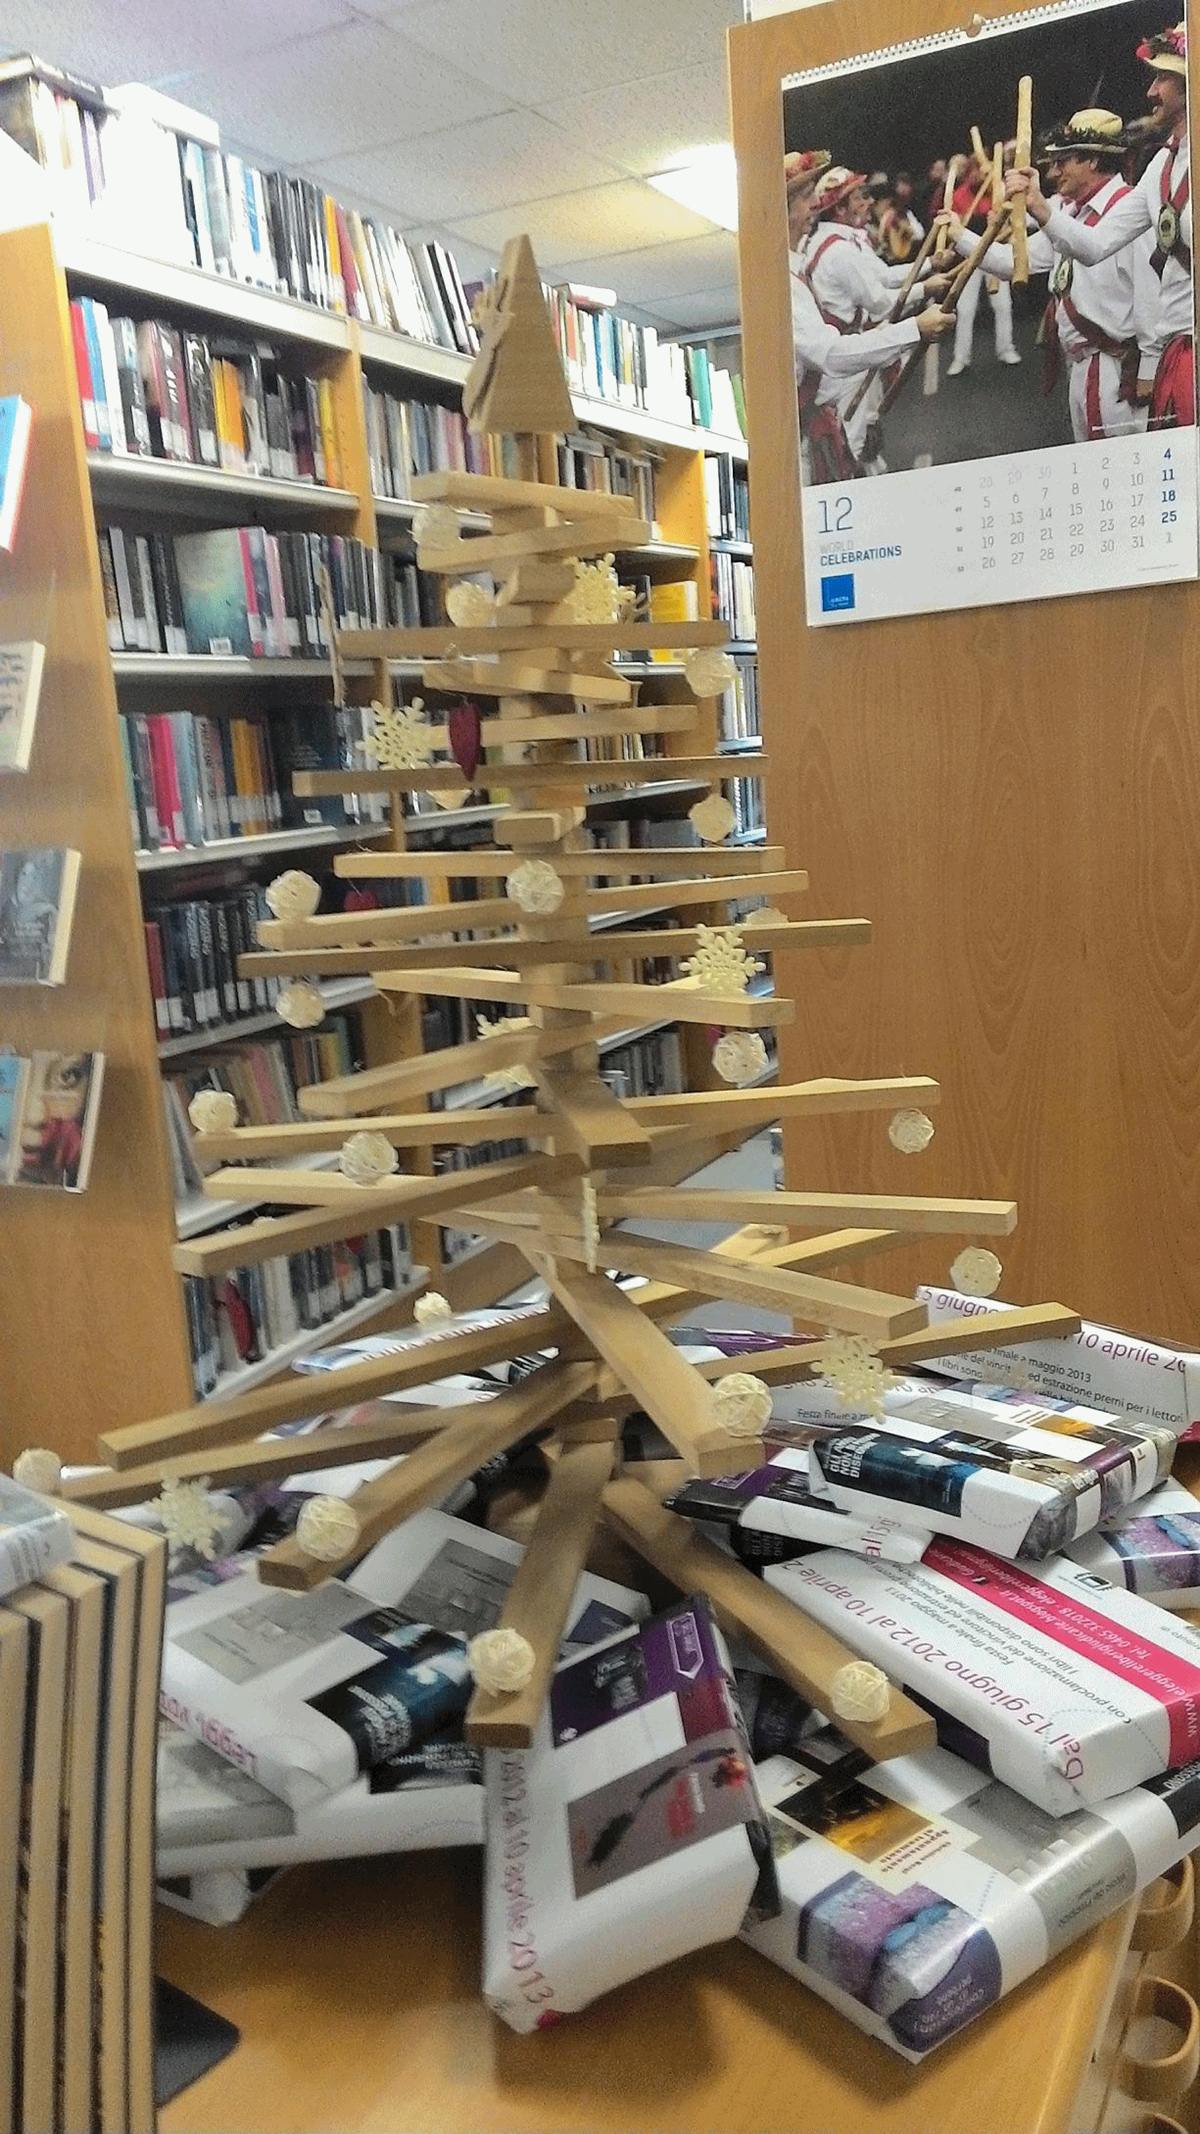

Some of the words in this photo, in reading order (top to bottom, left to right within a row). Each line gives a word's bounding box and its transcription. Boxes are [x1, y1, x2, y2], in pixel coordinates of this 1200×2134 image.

[1072, 463, 1078, 474] 1
[1102, 457, 1110, 469] 2
[1132, 453, 1141, 464] 3
[1163, 448, 1171, 459] 4
[983, 496, 991, 508] 5
[1012, 494, 1020, 504] 6
[1042, 487, 1048, 500] 7
[1072, 483, 1079, 495] 8
[1102, 477, 1110, 490] 9
[1130, 474, 1144, 486] 10
[1162, 469, 1175, 481] 11
[818, 497, 854, 534] 12
[981, 516, 995, 528] 12
[1010, 512, 1023, 525] 13
[1040, 507, 1053, 520] 14
[1070, 503, 1083, 516] 15
[1100, 499, 1113, 511] 16
[1131, 494, 1144, 507] 17
[1161, 490, 1176, 502] 18
[982, 536, 995, 549] 19
[1010, 532, 1025, 545] 20
[1040, 528, 1053, 541] 21
[1069, 523, 1085, 536] 22
[1100, 519, 1115, 532] 23
[1130, 515, 1145, 528] 24
[1161, 510, 1178, 524] 25
[820, 540, 854, 553] WORLD
[820, 545, 902, 567] CELEBRATIONS
[982, 556, 996, 569] 26
[1011, 552, 1025, 565] 27
[1040, 548, 1055, 561] 28
[1070, 544, 1085, 557] 29
[1100, 540, 1115, 553] 30
[1131, 536, 1145, 549] 31
[1165, 532, 1173, 543] 1
[1077, 1331, 1099, 1349] 10
[1101, 1340, 1160, 1367] aprile
[1028, 1357, 1065, 1376] maggio
[1067, 1367, 1091, 1383] 2013
[1028, 1371, 1040, 1382] ed
[1042, 1376, 1093, 1399] estrazione
[1094, 1392, 1125, 1409] premi
[1126, 1401, 1144, 1414] per
[800, 1567, 853, 1600] aprile
[845, 1599, 875, 1617] 10
[909, 1600, 950, 1626] maggio
[866, 1614, 898, 1630] al
[966, 1608, 1023, 1642] disponibili
[889, 1626, 949, 1664] 2012
[955, 1628, 987, 1649] finale
[1003, 1643, 1027, 1658] del
[1020, 1638, 1051, 1658] sono
[1099, 1629, 1132, 1650] 0465
[984, 1645, 1015, 1667] Festa
[1130, 1644, 1153, 1661] Tel.
[944, 1659, 1031, 1712] giugno
[1023, 1656, 1111, 1707] proclamazione
[1017, 1712, 1054, 1735] 15
[509, 1931, 555, 2004] 2013
